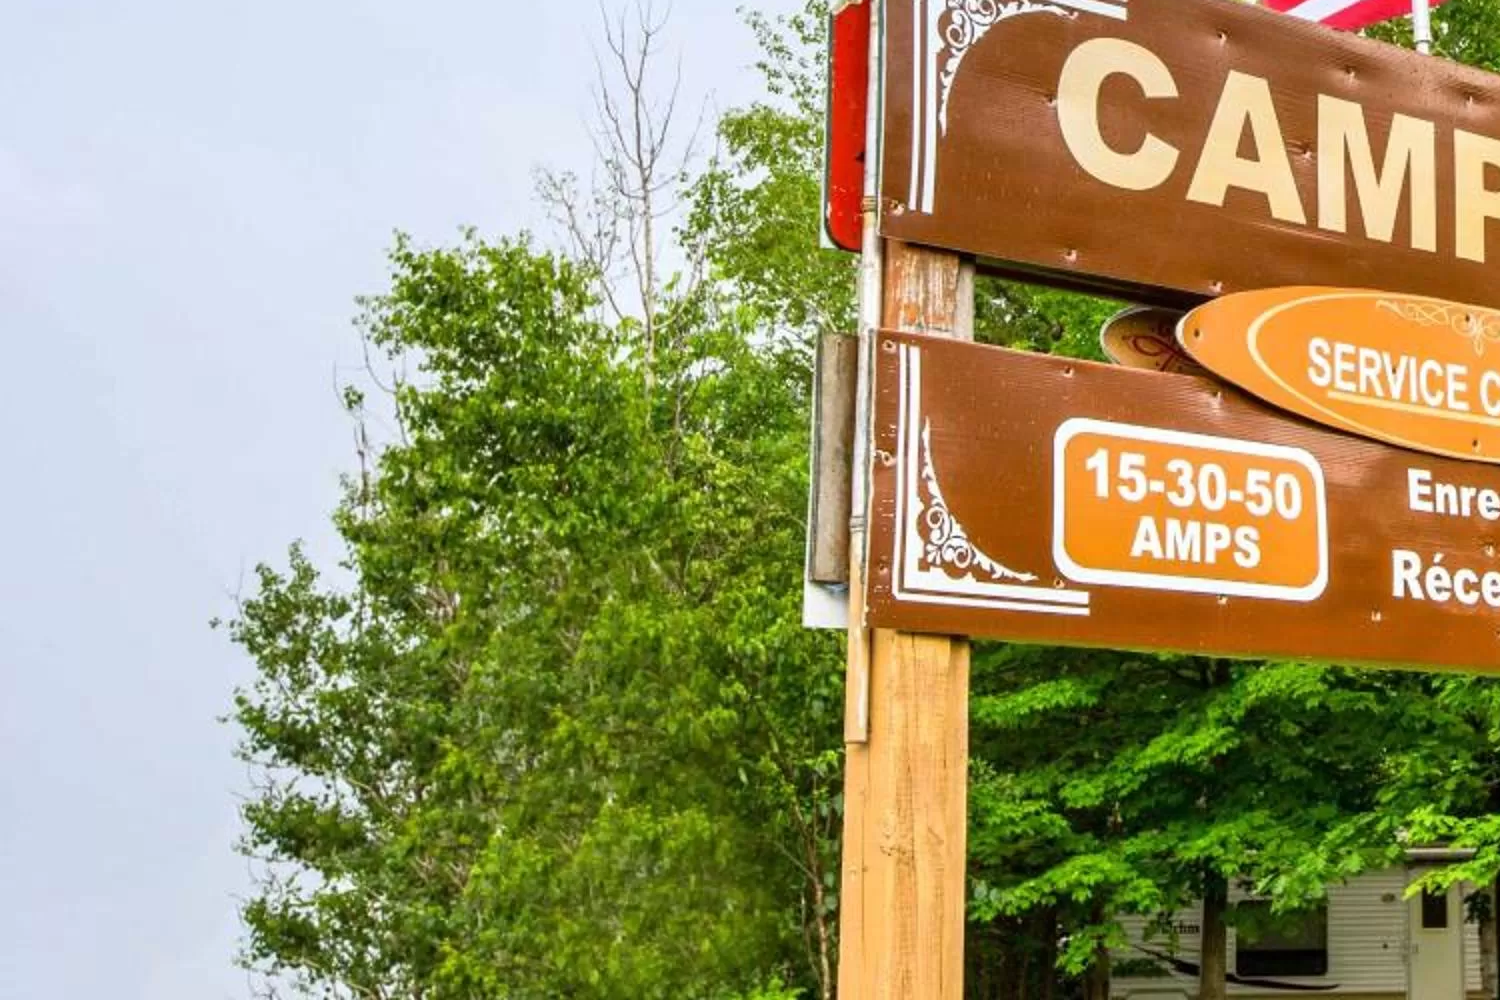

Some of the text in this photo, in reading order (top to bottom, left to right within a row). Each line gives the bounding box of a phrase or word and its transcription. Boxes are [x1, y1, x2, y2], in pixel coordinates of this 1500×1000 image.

[1307, 337, 1470, 411] SERVICE
[1084, 447, 1302, 520] 15-30-50
[1131, 515, 1261, 569] AMPS
